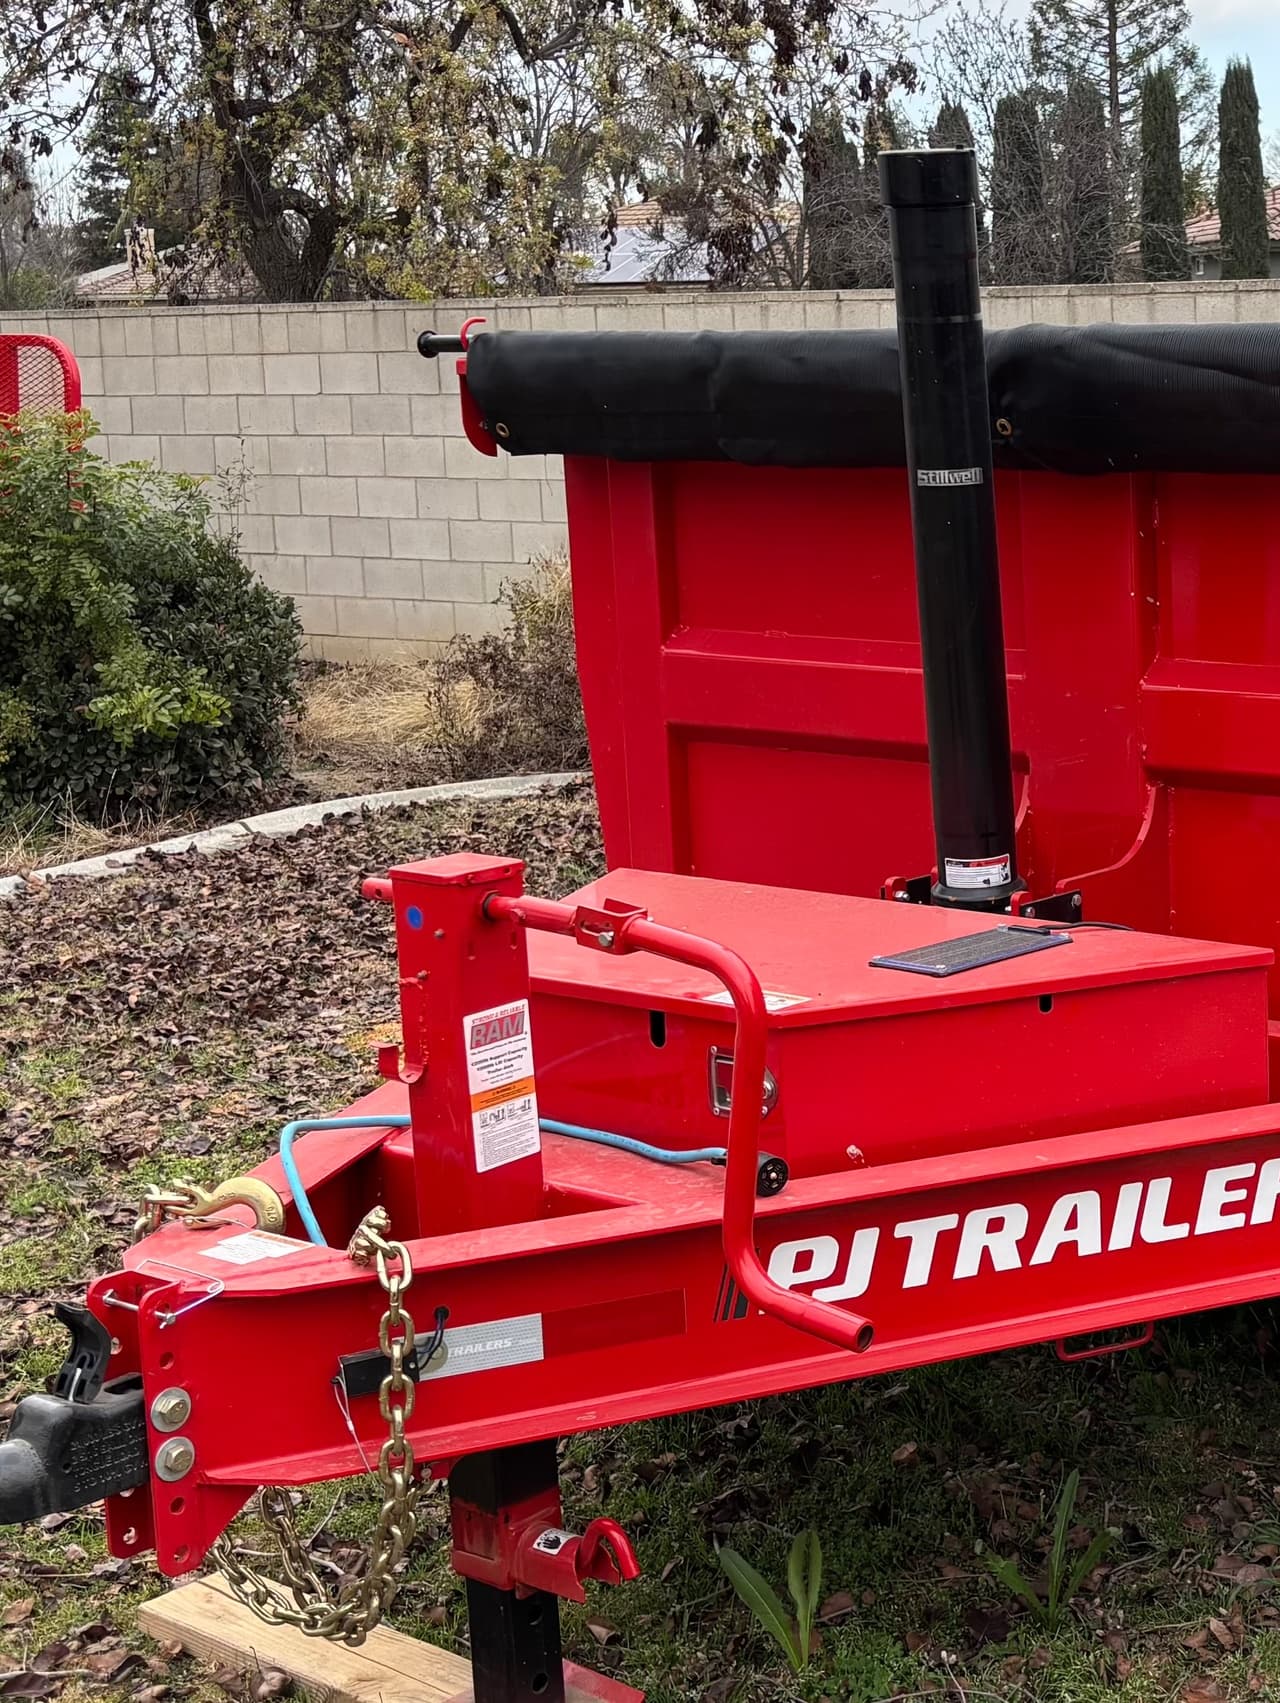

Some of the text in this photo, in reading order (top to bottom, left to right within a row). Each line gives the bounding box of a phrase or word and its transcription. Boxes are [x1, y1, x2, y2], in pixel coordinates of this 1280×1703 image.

[917, 468, 983, 486] Stillwell
[470, 1011, 526, 1050] RAM
[759, 1227, 881, 1313] PJ
[447, 1337, 514, 1359] TRAILERS
